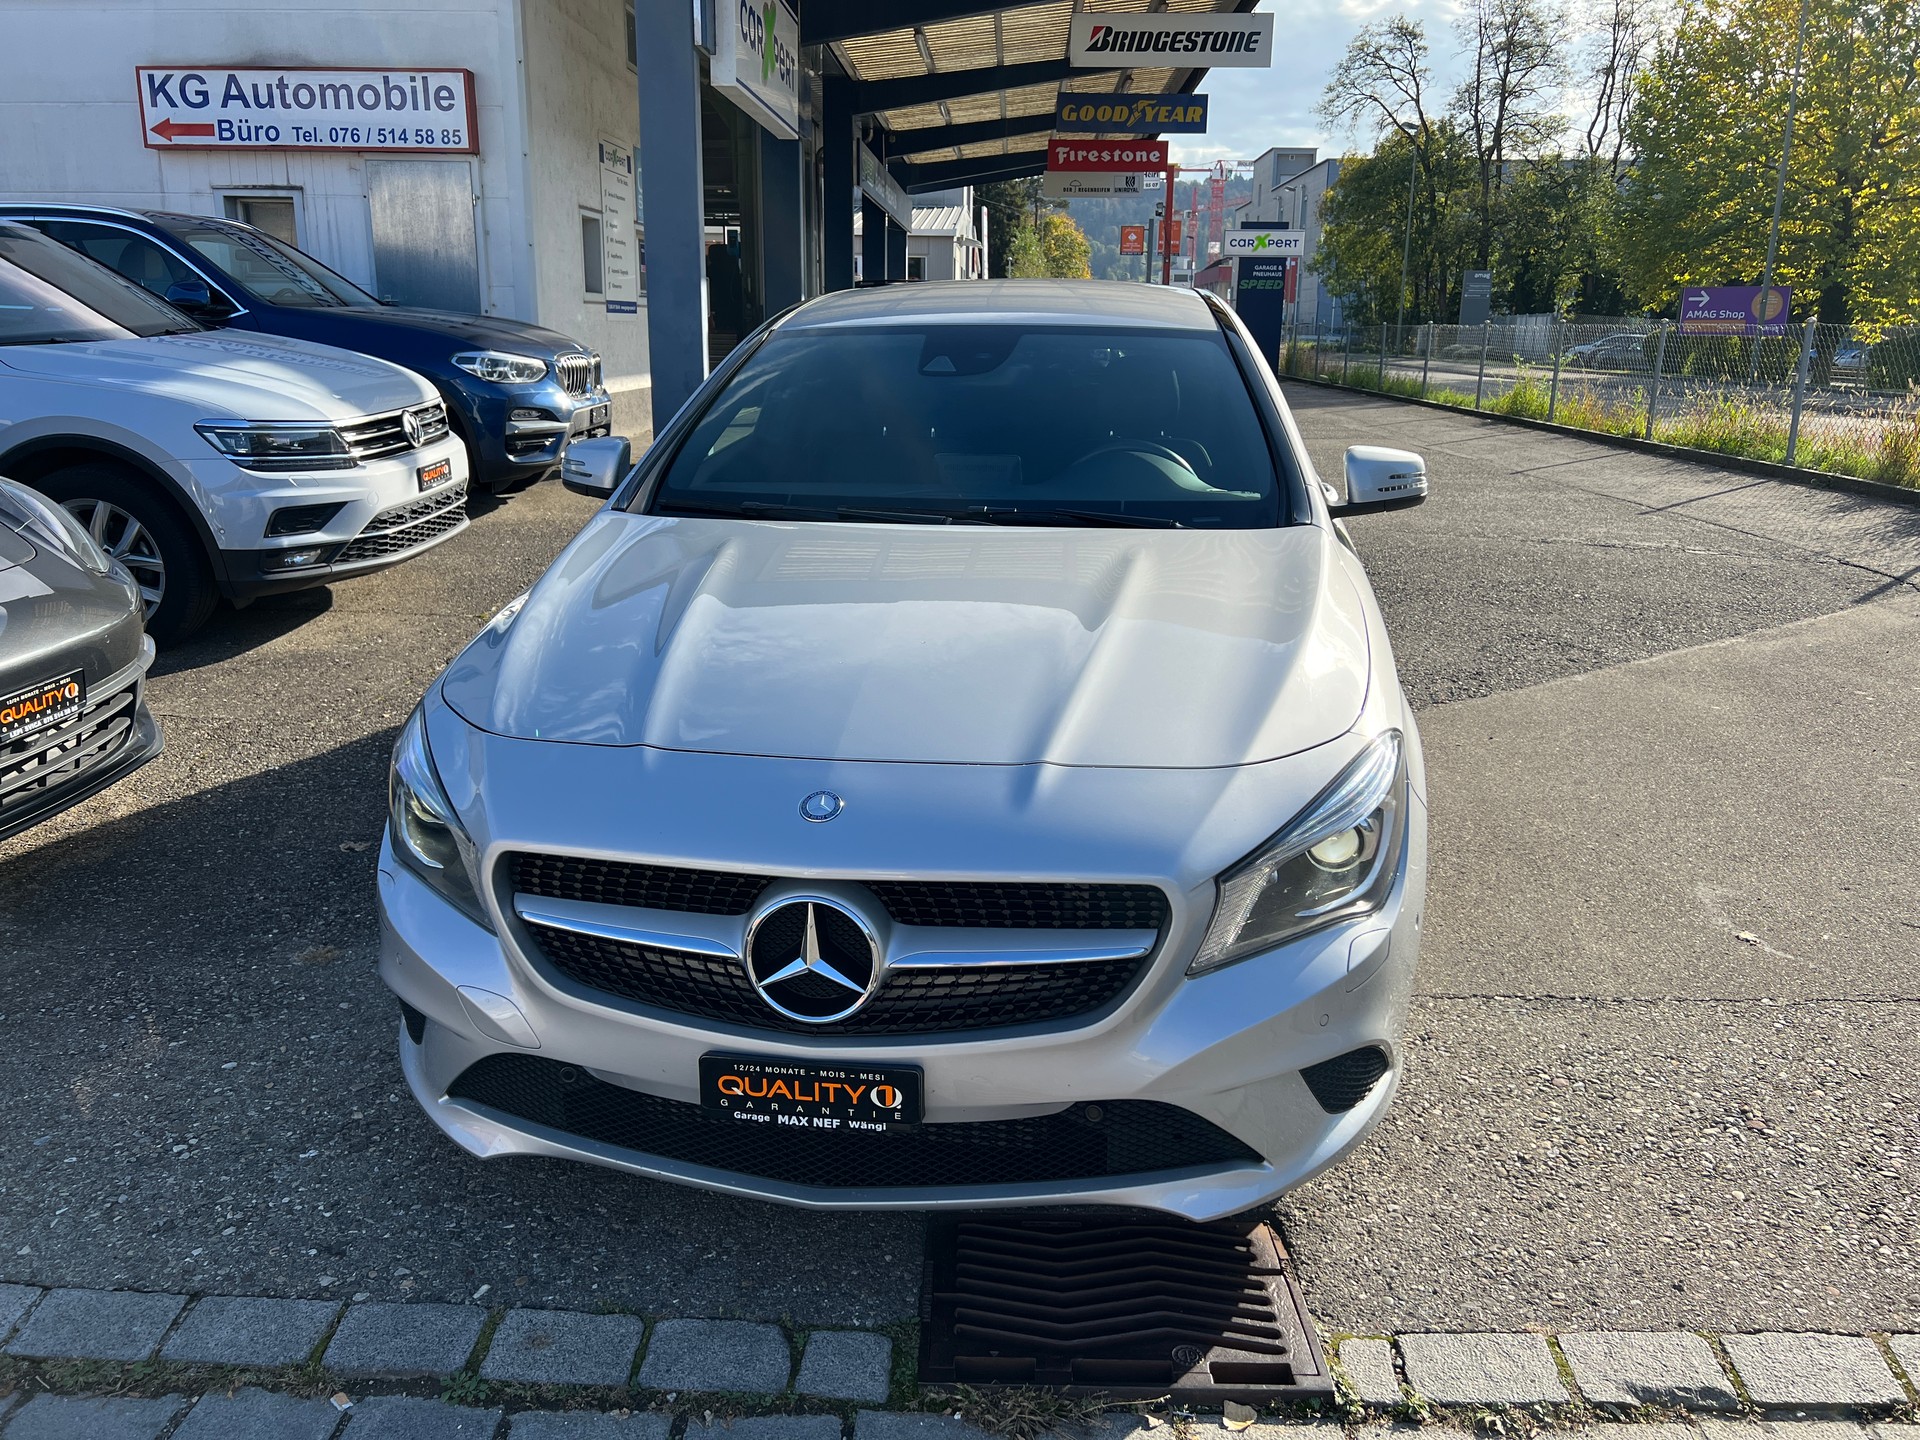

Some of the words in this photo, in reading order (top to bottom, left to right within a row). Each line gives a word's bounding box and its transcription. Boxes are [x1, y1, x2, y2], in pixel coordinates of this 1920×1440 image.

[1085, 26, 1261, 53] BRIDGESTONE
[147, 74, 209, 108] KG
[221, 74, 456, 111] Automobile
[217, 119, 281, 142] Büro
[292, 126, 323, 143] Tel.
[329, 127, 361, 144] 076
[377, 128, 408, 144] 514
[414, 128, 435, 145] 58
[441, 129, 462, 145] 85
[1056, 147, 1160, 165] Firestone
[1239, 280, 1284, 289] SPEED
[1686, 310, 1717, 318] AMAG
[1719, 310, 1745, 319] Shop
[0, 687, 64, 724] QUALITY
[733, 1064, 761, 1072] 12/24
[765, 1066, 806, 1076] MONATE
[820, 1070, 845, 1078] MOIS
[860, 1072, 885, 1081] MESI
[717, 1075, 866, 1105] QUALITY
[720, 1098, 902, 1120] GARANTIE
[733, 1111, 771, 1122] Garage
[777, 1114, 809, 1127] MAX
[813, 1117, 841, 1129] NEF
[849, 1120, 887, 1132] Wängi
